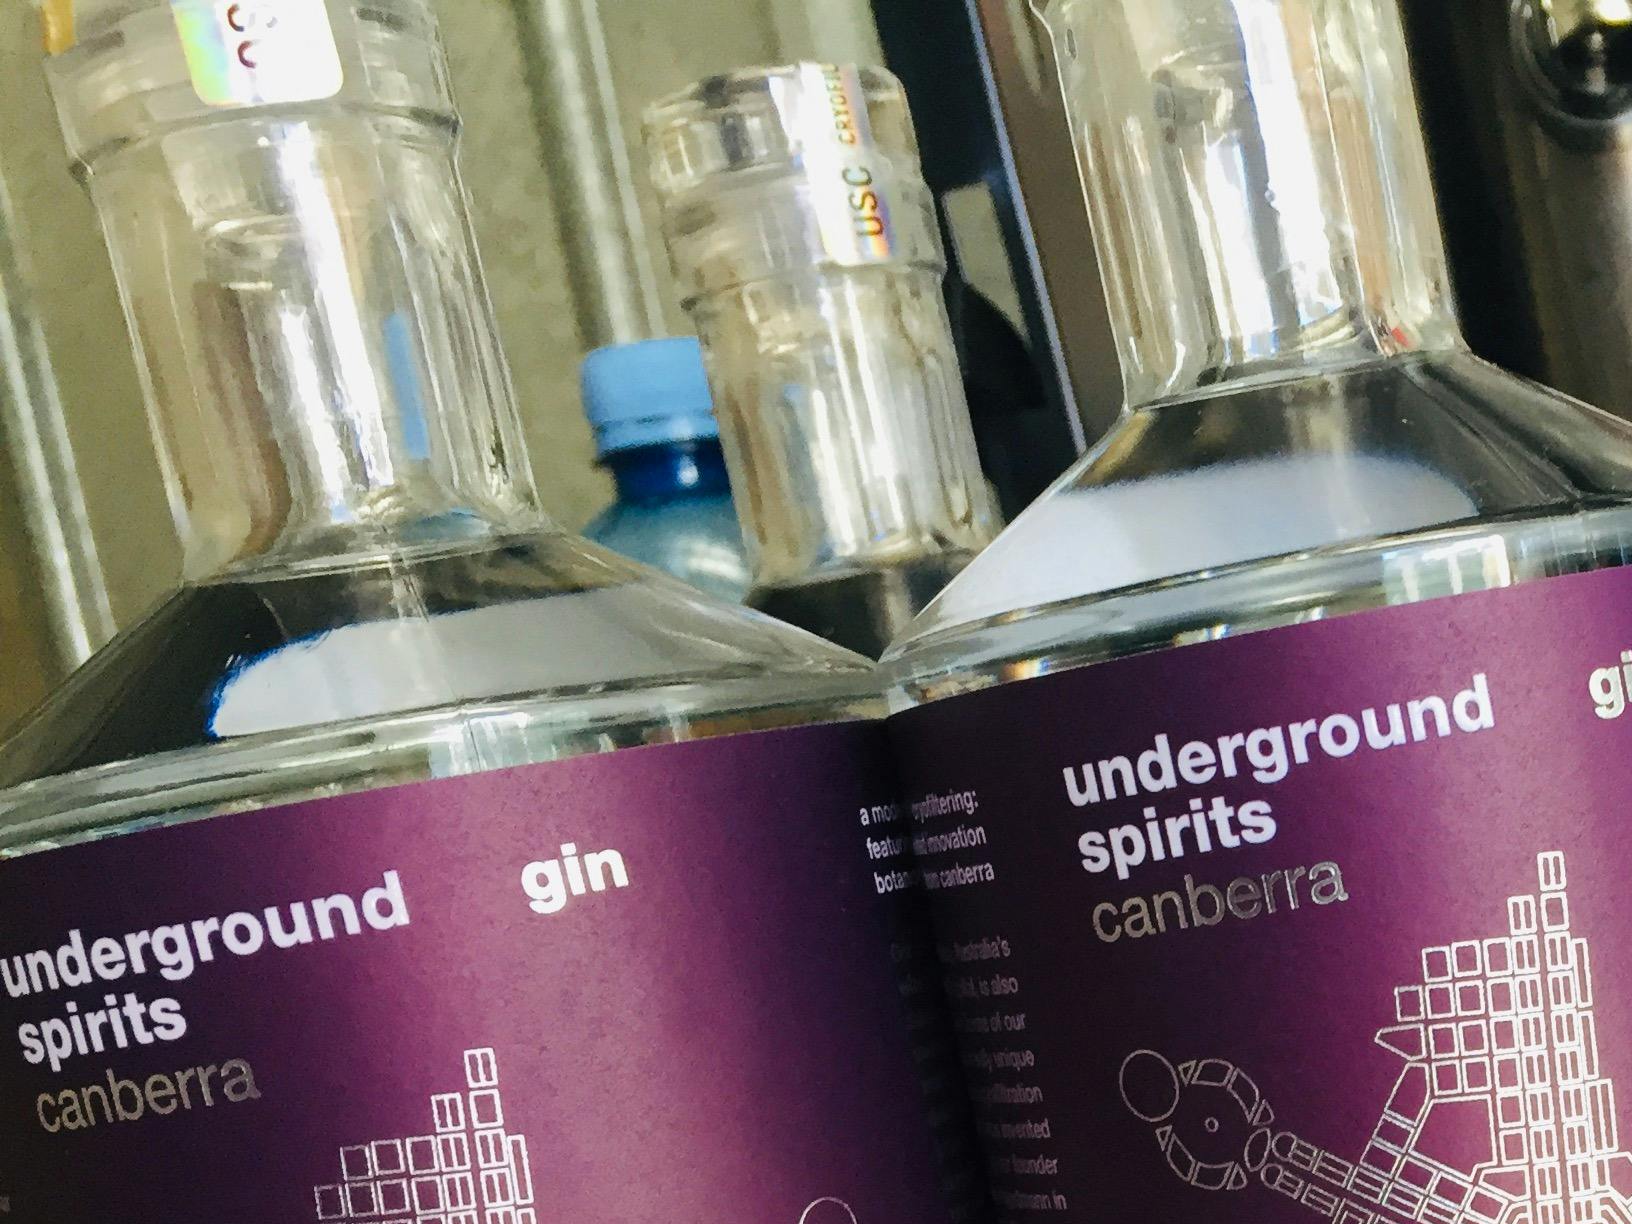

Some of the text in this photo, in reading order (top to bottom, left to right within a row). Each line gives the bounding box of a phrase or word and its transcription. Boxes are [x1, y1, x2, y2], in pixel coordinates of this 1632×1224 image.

[842, 167, 883, 236] USC
[1062, 672, 1495, 808] underground
[860, 808, 870, 826] a
[1078, 797, 1276, 880] spirits
[0, 842, 629, 1000] underground gin
[1092, 861, 1348, 944] canberra
[16, 992, 188, 1072] spirits
[35, 1057, 260, 1134] canberra
